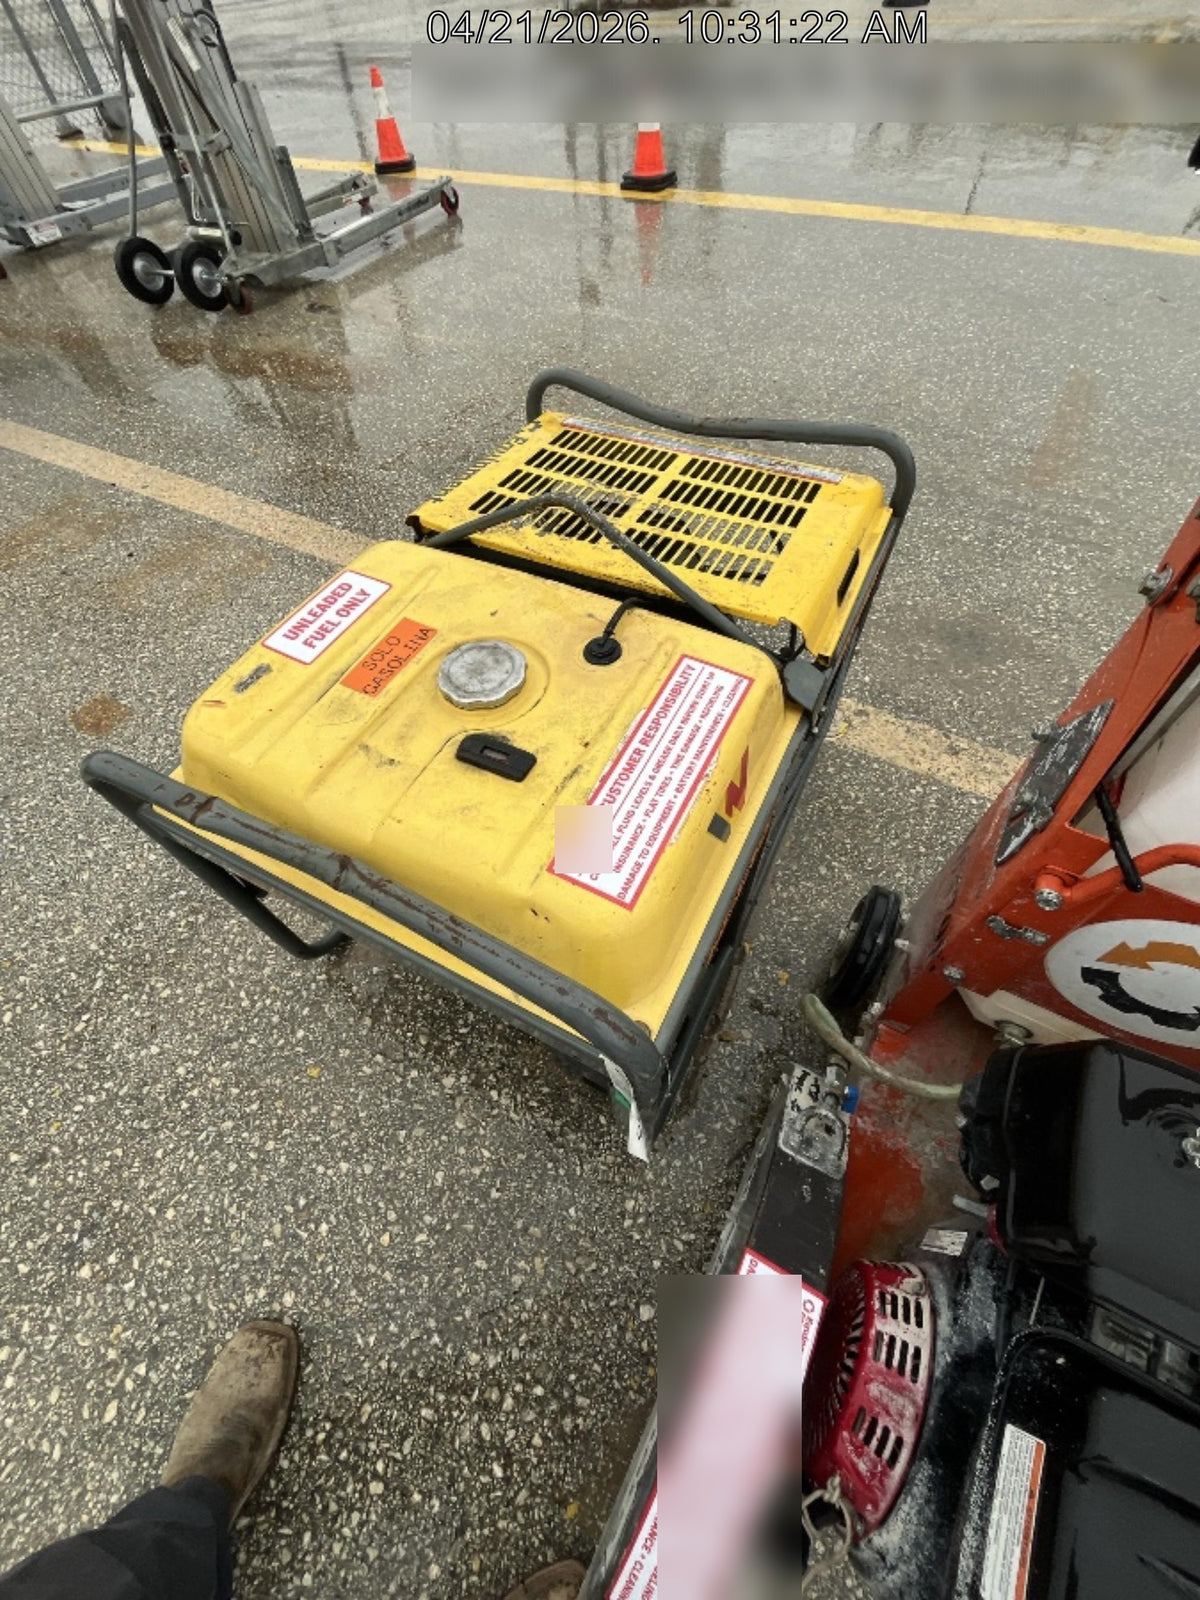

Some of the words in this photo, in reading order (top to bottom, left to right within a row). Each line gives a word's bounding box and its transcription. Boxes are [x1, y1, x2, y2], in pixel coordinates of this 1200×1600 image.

[282, 582, 353, 641] UNLEADED
[303, 617, 341, 649] FUEL
[336, 587, 372, 618] ONLY
[361, 626, 431, 695] GASOLINA
[601, 746, 647, 807] USTOMER
[637, 663, 697, 747] RESPONSIBILITY
[610, 822, 646, 874] INSURANCE
[615, 859, 644, 901] DAMAGE
[637, 846, 651, 861] TO
